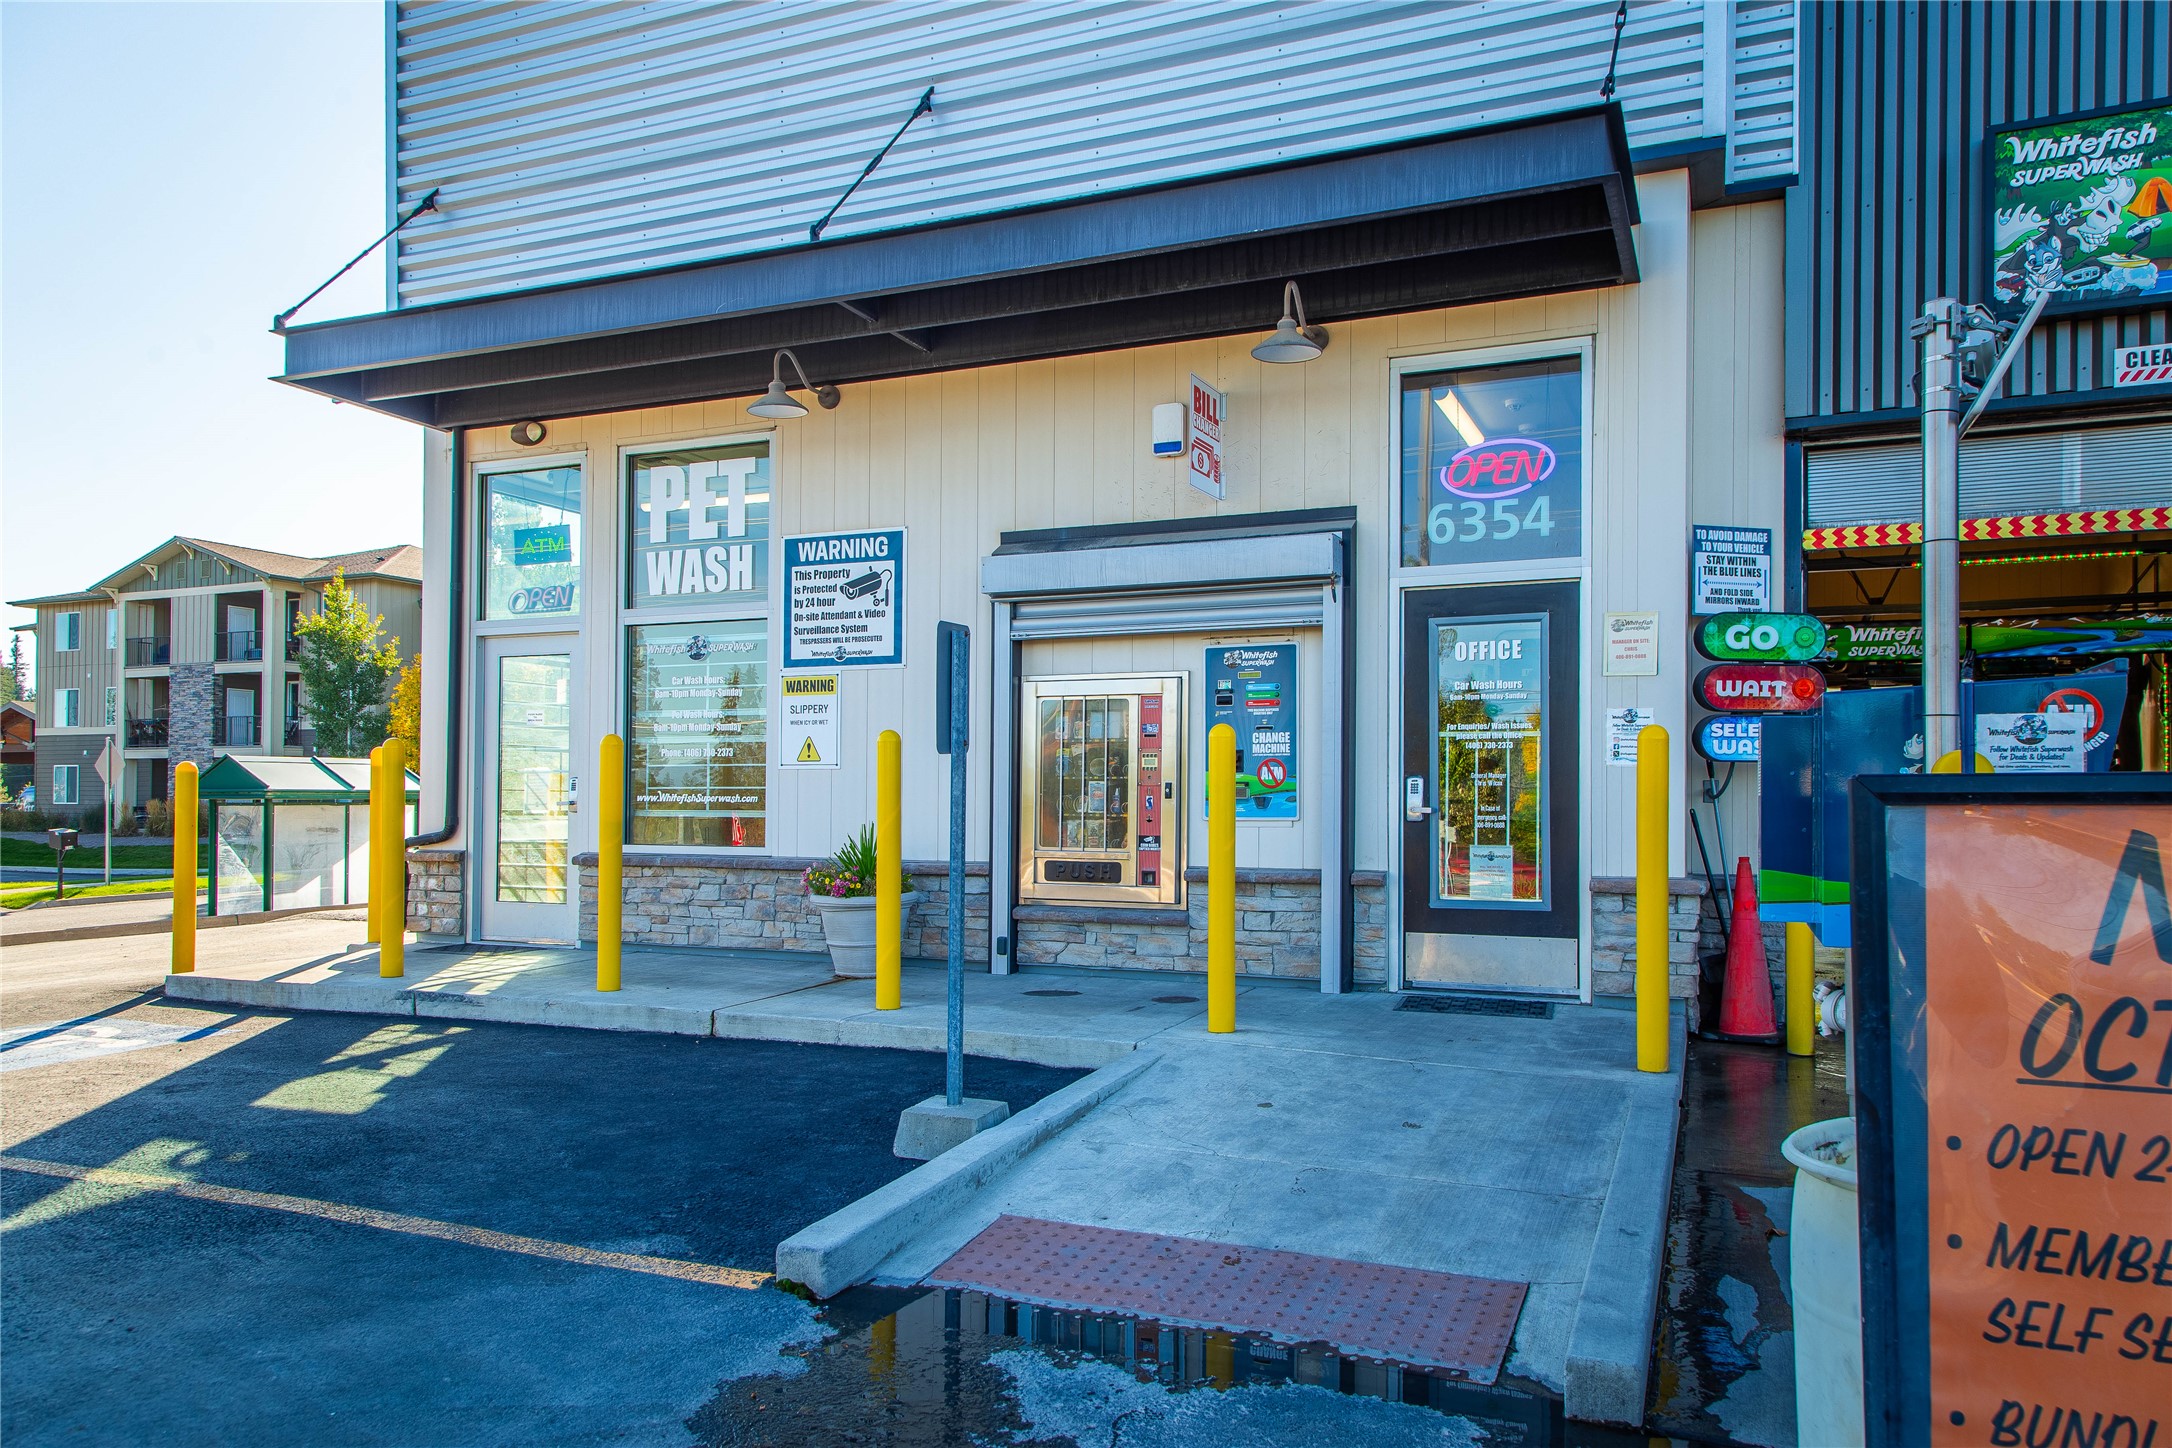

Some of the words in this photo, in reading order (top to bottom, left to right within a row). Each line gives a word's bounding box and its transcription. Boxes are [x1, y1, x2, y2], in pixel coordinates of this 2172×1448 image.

[2004, 122, 2157, 165] Whitefish
[2010, 152, 2144, 188] SUPERWASH
[1193, 385, 1219, 427] BILL
[1193, 412, 1220, 443] CHANGER
[1447, 449, 1546, 488] OPEN
[650, 457, 756, 543] PET
[1428, 496, 1555, 544] 6354
[1696, 529, 1707, 540] TO
[1708, 530, 1733, 541] AVOID
[1734, 531, 1768, 543] DAMAGE
[521, 536, 565, 554] ATM
[798, 536, 888, 562] WARNING
[1701, 541, 1711, 551] TO
[1712, 542, 1733, 552] YOUR
[1734, 543, 1764, 553] VEHICLE
[1706, 555, 1725, 565] STAY
[1727, 556, 1757, 566] WITHIN
[646, 545, 753, 595] WASH
[794, 570, 812, 581] This
[814, 568, 850, 581] Property
[1703, 566, 1717, 576] THE
[1719, 567, 1738, 577] BLUE
[1740, 567, 1762, 578] LINES
[794, 586, 802, 594] is
[802, 583, 837, 594] Protected
[1710, 588, 1722, 596] AND
[1724, 588, 1738, 596] FOLD
[1739, 589, 1753, 597] SIDE
[508, 586, 572, 613] OPEN
[794, 599, 803, 609] by
[805, 598, 815, 608] 24
[816, 597, 836, 607] hour
[1705, 596, 1733, 605] MIRRORS
[1735, 597, 1760, 606] INWARD
[794, 611, 819, 622] On-site
[820, 610, 856, 621] Attendant
[857, 610, 863, 619] &
[864, 609, 886, 619] Video
[794, 625, 840, 636] Surveillance
[840, 624, 868, 634] System
[799, 637, 832, 645] TRESPASSERS
[851, 635, 883, 643] PROSECUTED
[1725, 624, 1779, 651] GO
[646, 643, 687, 656] Whitefish
[707, 641, 756, 653] SUPERWASH
[1454, 639, 1522, 662] OFFICE
[1240, 650, 1278, 661] Whitefish
[1240, 659, 1275, 667] SUPERWASH
[672, 677, 684, 685] Car
[684, 676, 703, 685] Wash
[704, 675, 726, 684] Hours:
[785, 679, 834, 693] WARNING
[1454, 681, 1469, 690] Car
[1471, 680, 1495, 690] Wash
[1496, 680, 1523, 689] Hours
[654, 690, 689, 698] 6am-10pm
[690, 687, 743, 698] Monday-Sunday
[1715, 680, 1787, 698] WAIT
[1480, 692, 1528, 700] Monday-Sunday
[790, 704, 829, 714] SLIPPERY
[689, 722, 742, 732] Monday-Sunday
[1446, 723, 1457, 731] For
[1458, 723, 1490, 731] Enquiries/
[1711, 723, 1759, 737] SELE
[1987, 727, 2020, 737] Whitefish
[1252, 732, 1291, 743] CHANGE
[2082, 731, 2110, 752] NGER
[1252, 743, 1291, 753] MACHINE
[1465, 741, 1483, 749] (406)
[1484, 741, 1514, 749] 730-2373
[1989, 745, 2008, 753] Follow
[2009, 745, 2039, 753] Whitefish
[2040, 745, 2074, 754] Superwash
[661, 748, 683, 757] Phone:
[684, 748, 702, 757] (406)
[1998, 753, 2009, 761] for
[2009, 753, 2028, 761] Deals
[2036, 753, 2065, 761] Updates!
[636, 791, 758, 804] www.WhitefishSuperwash.com
[1055, 862, 1112, 880] PUSH
[1987, 1123, 2127, 1179] OPEN
[2134, 1134, 2172, 1183] 2
[1982, 1297, 2114, 1354] SELF
